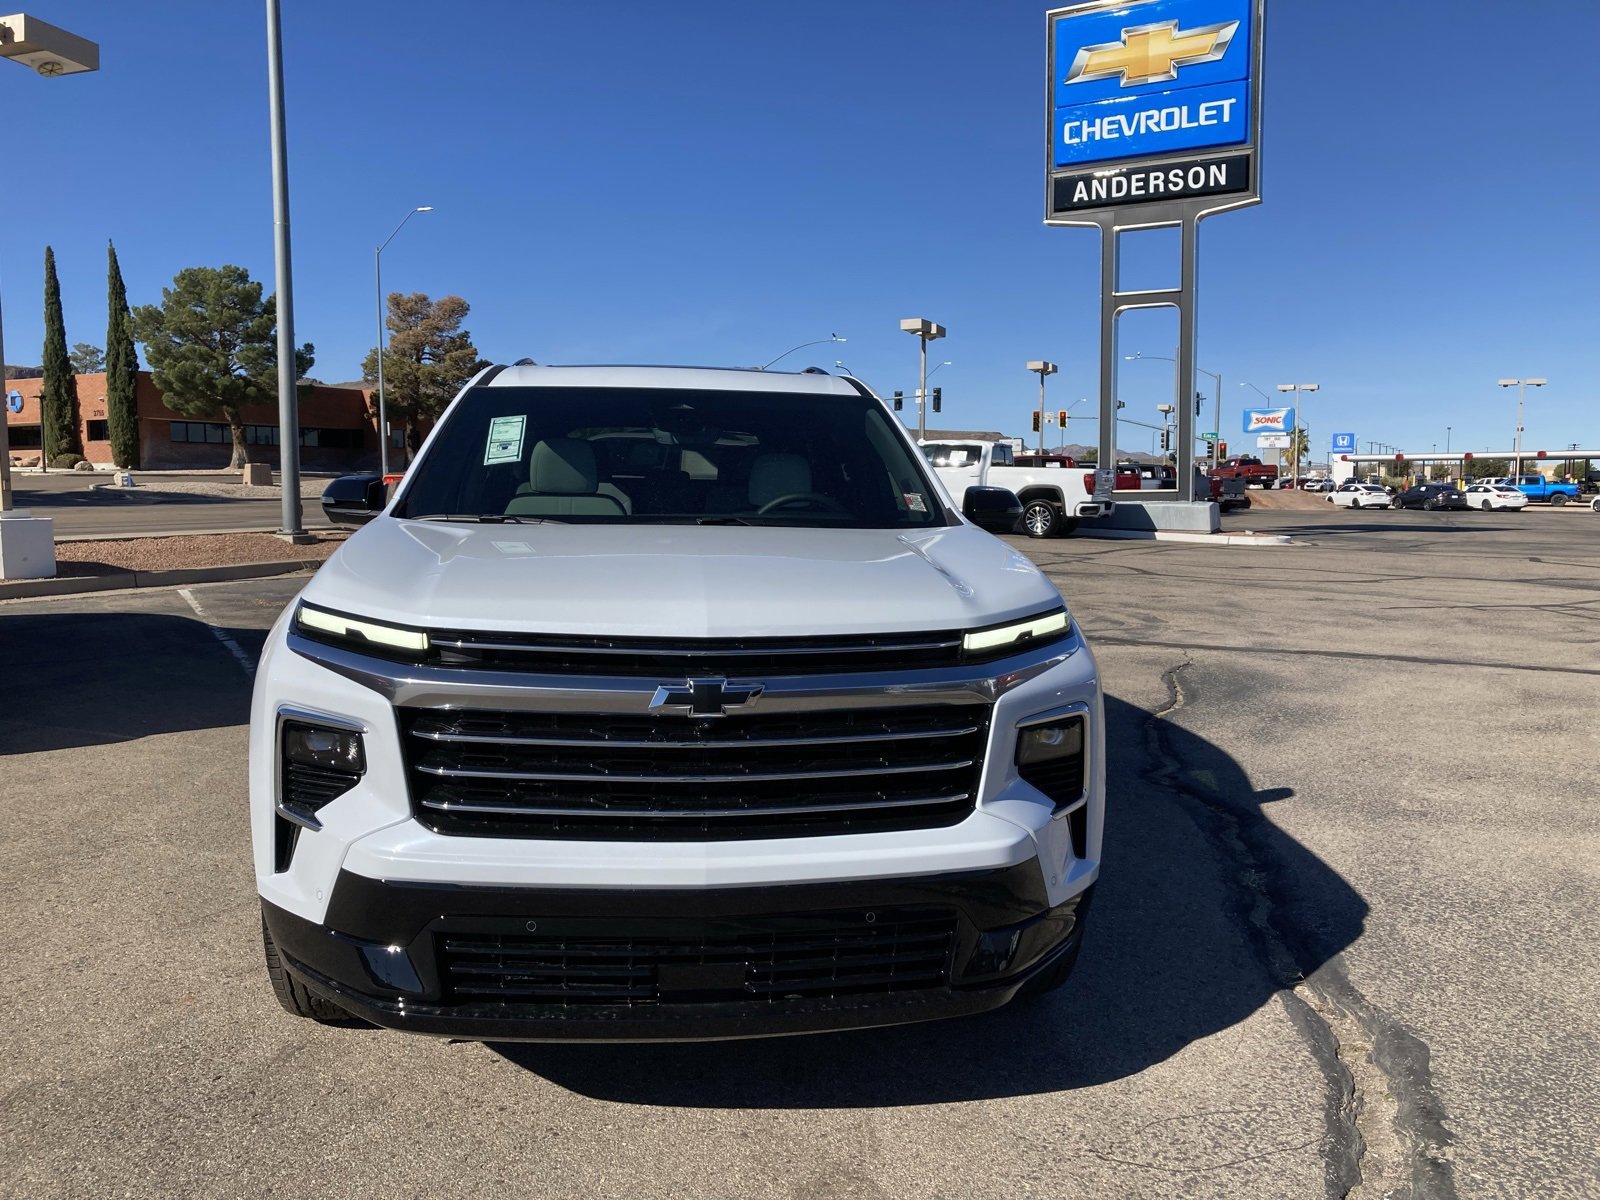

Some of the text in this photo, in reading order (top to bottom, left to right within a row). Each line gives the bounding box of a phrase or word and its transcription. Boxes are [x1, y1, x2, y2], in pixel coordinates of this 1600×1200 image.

[1063, 98, 1237, 145] CHEVROLET
[1072, 163, 1228, 203] ANDERSON
[1253, 416, 1282, 424] SONIC
